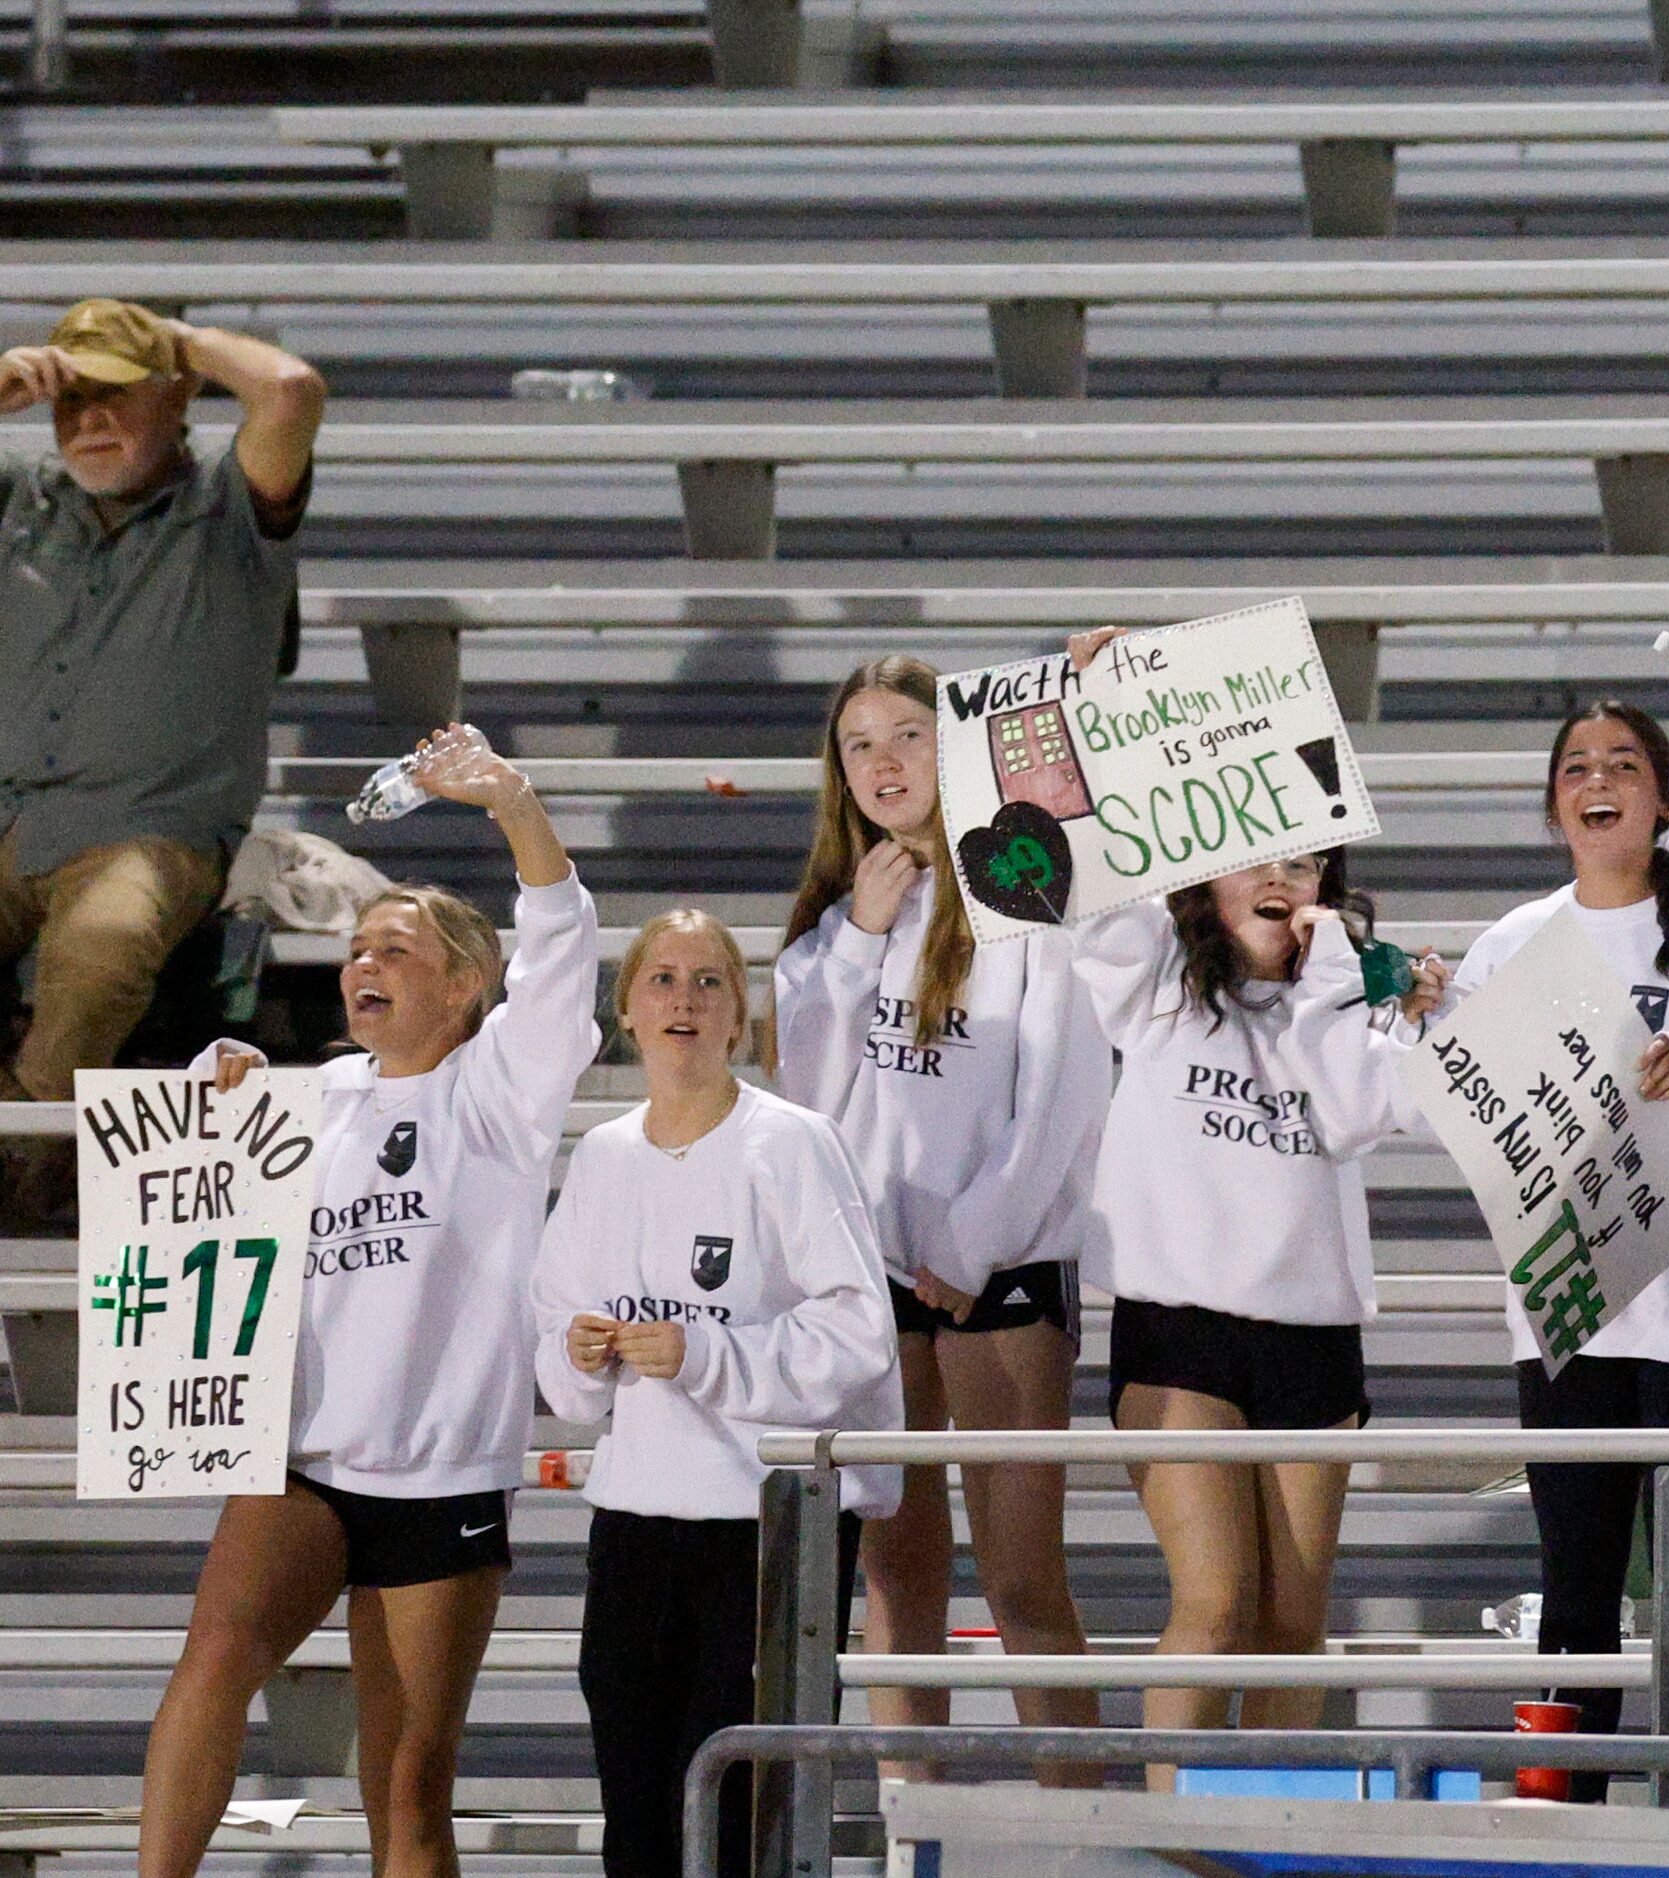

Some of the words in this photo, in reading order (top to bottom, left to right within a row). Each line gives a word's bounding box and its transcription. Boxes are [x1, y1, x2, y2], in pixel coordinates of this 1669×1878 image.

[946, 665, 1082, 722] Wacth
[1107, 644, 1169, 685] the
[1075, 685, 1221, 753] Brooklyn
[1224, 657, 1317, 706] Miller
[1159, 739, 1191, 767] is
[1200, 716, 1272, 757] gonna
[1432, 1036, 1506, 1125] sister
[1558, 1027, 1596, 1082] her
[84, 1080, 220, 1168] HAVE
[234, 1091, 314, 1180] NO
[1527, 1071, 1585, 1156] blink
[1590, 1073, 1629, 1134] miss
[1492, 1111, 1542, 1177] my
[1611, 1132, 1643, 1181] will
[139, 1161, 234, 1225] FEAR
[311, 1190, 430, 1237] OSPER
[303, 1237, 410, 1279] OCCER
[1510, 1199, 1607, 1360] #11
[91, 1237, 280, 1360] #17
[110, 1380, 144, 1432] IS
[168, 1374, 249, 1429] HERE
[128, 1445, 175, 1491] go
